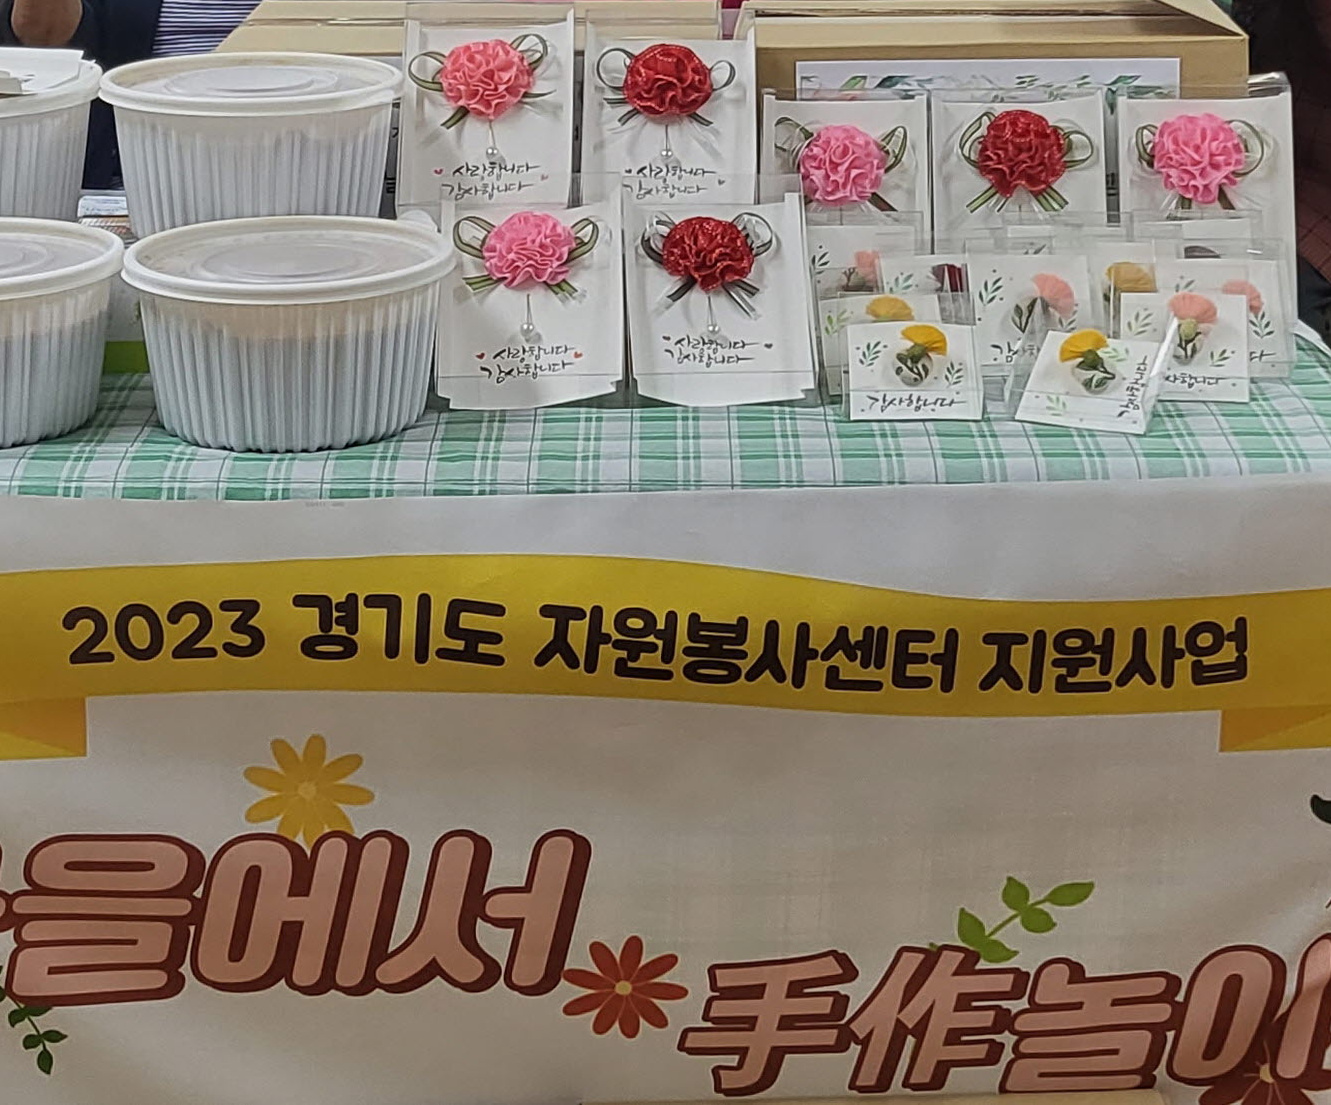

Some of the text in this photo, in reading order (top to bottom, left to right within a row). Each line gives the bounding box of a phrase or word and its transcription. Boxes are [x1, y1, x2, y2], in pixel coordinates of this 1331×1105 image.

[452, 162, 540, 183] 사랑합니다
[636, 162, 717, 184] 사랑합니다
[441, 180, 536, 201] 감사합니다
[625, 182, 709, 199] 감사합니다
[492, 345, 576, 363] 사랑합니다
[674, 336, 760, 352] 사랑합니다
[665, 349, 756, 364] 감사합니다
[480, 360, 576, 383] 감사합니다
[1165, 373, 1230, 389] 사합니다
[866, 393, 967, 413] 감사합니다
[61, 592, 1249, 695] 2023 경기도 자원봉사센터 지원사업
